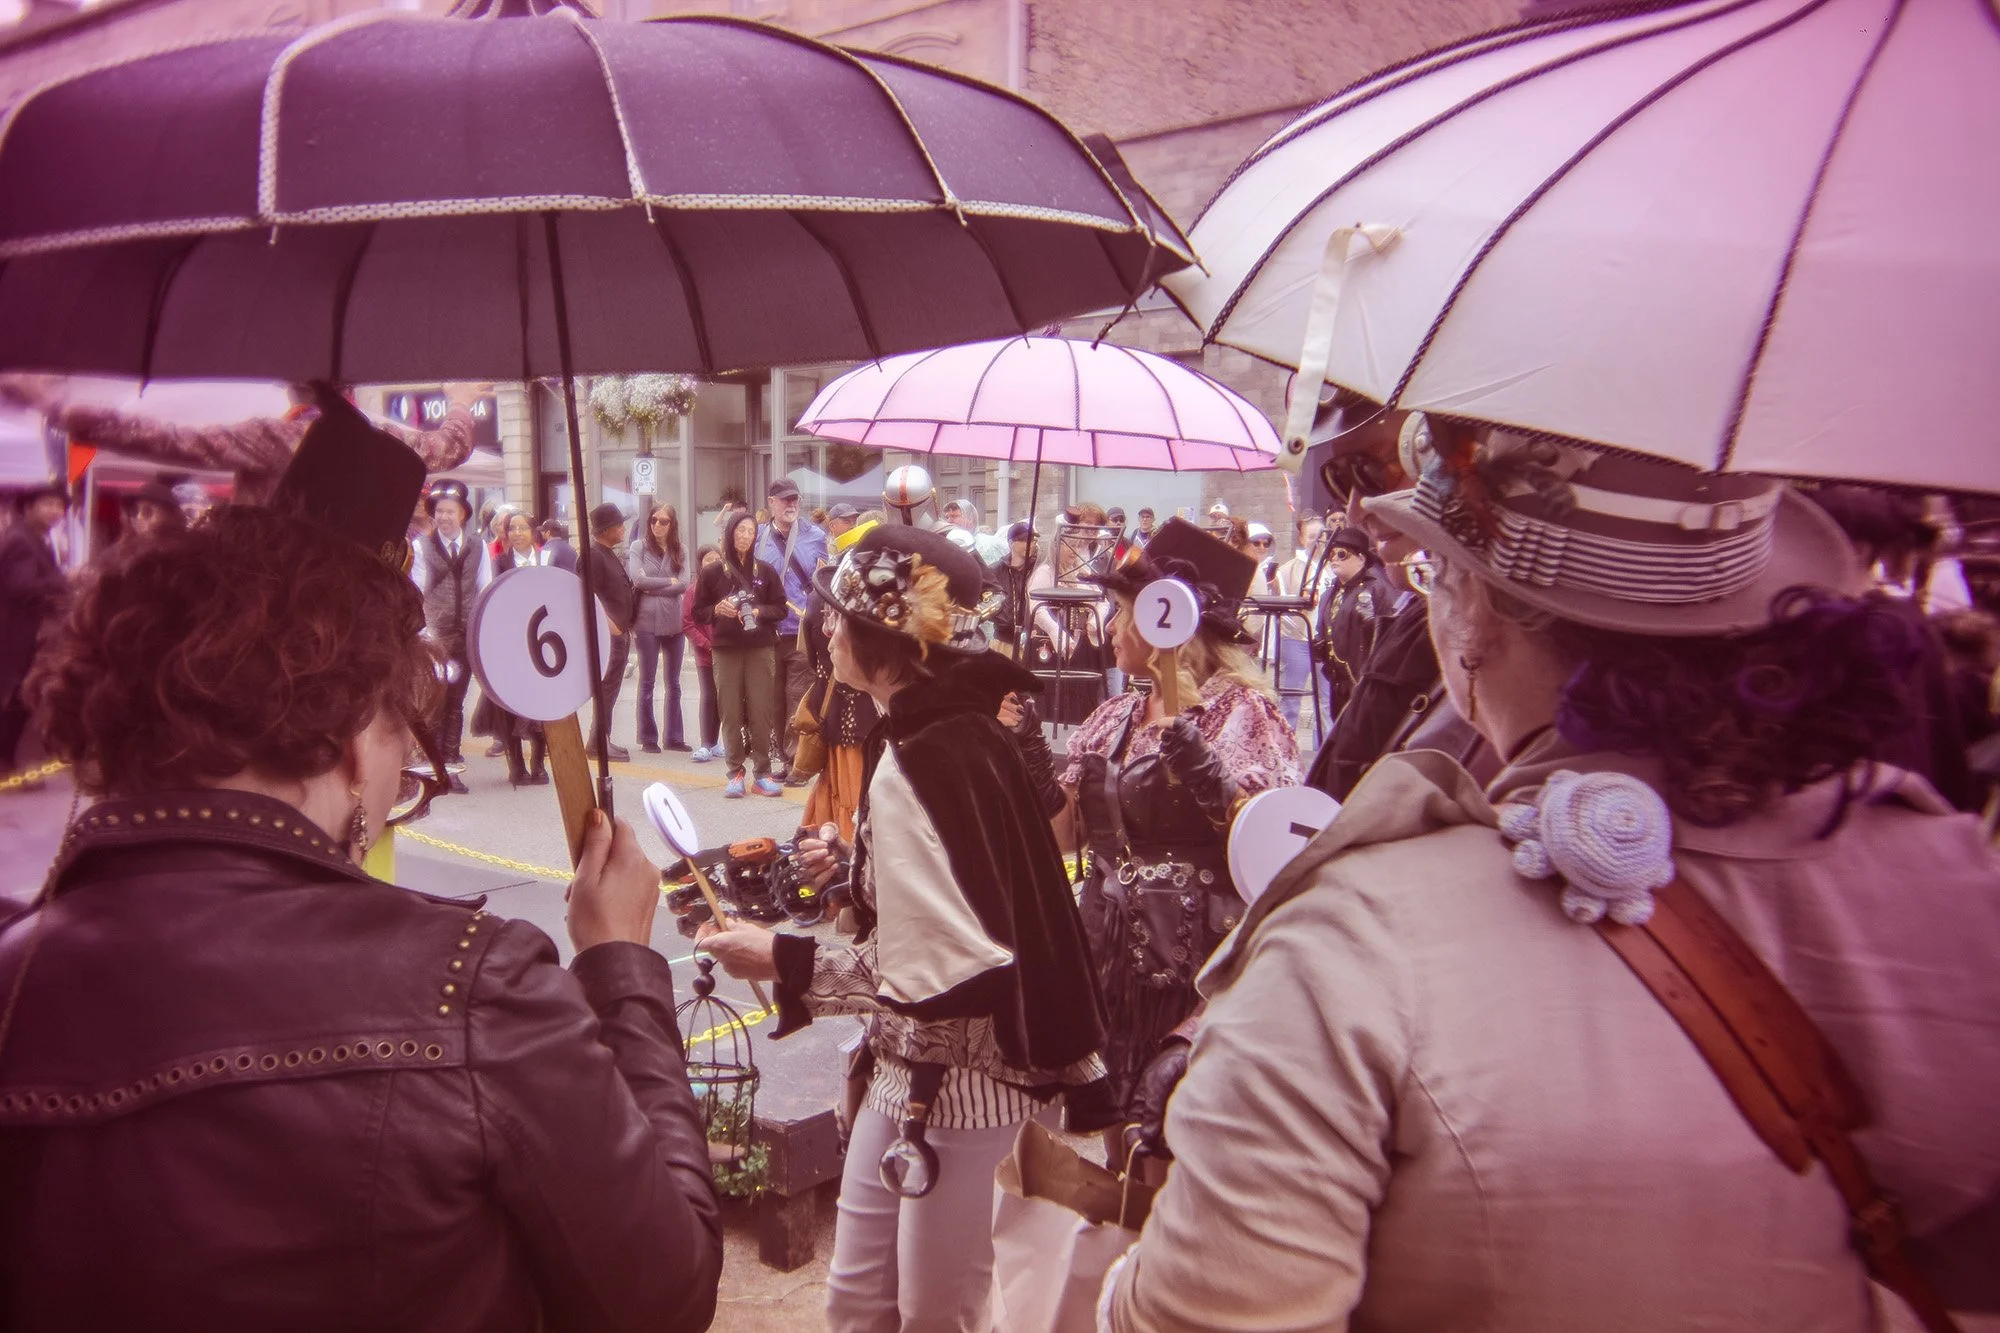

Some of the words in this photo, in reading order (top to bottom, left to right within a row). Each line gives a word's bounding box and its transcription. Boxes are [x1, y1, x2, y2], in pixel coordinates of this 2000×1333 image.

[1157, 597, 1172, 629] 2
[527, 604, 568, 678] 6
[663, 797, 683, 831] 1
